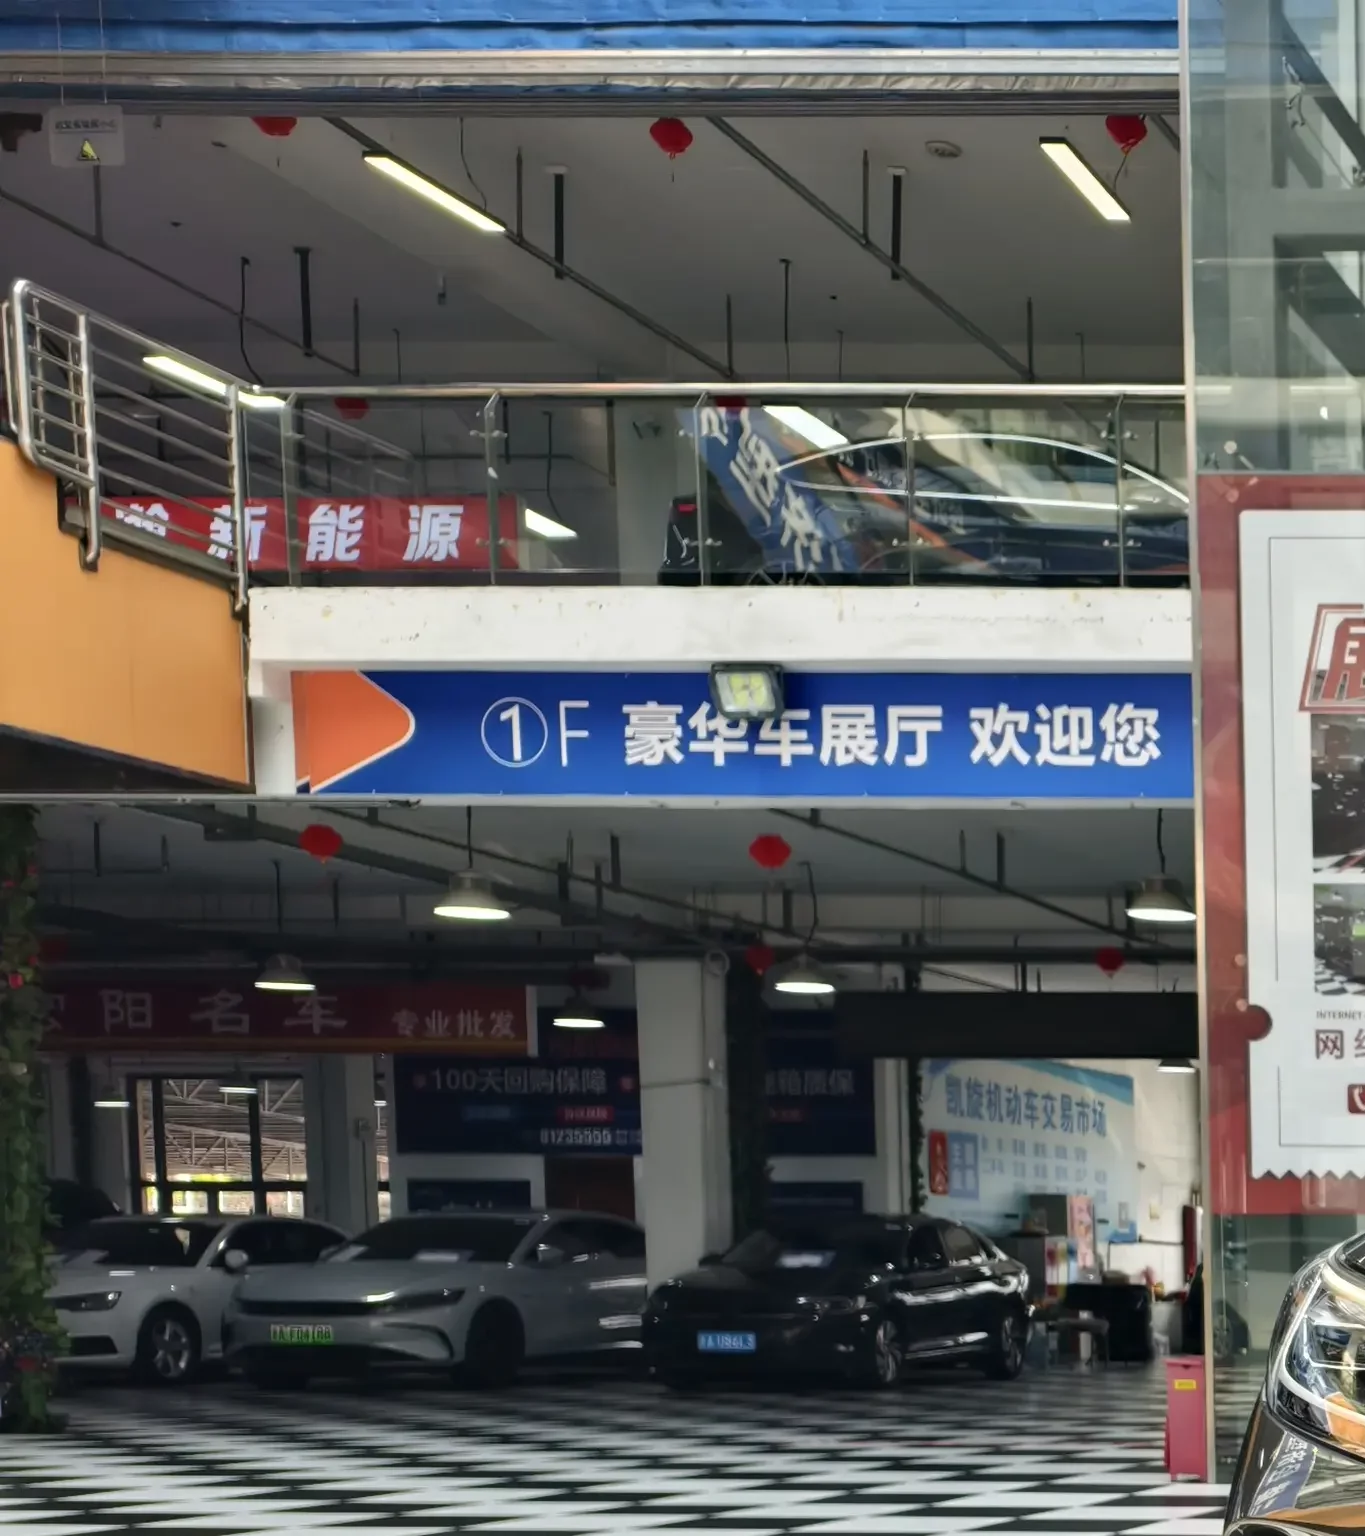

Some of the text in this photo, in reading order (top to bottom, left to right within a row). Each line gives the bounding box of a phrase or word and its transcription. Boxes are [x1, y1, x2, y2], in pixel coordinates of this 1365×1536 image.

[621, 702, 943, 767] 豪华车展厅
[968, 703, 1162, 767] 欢迎您
